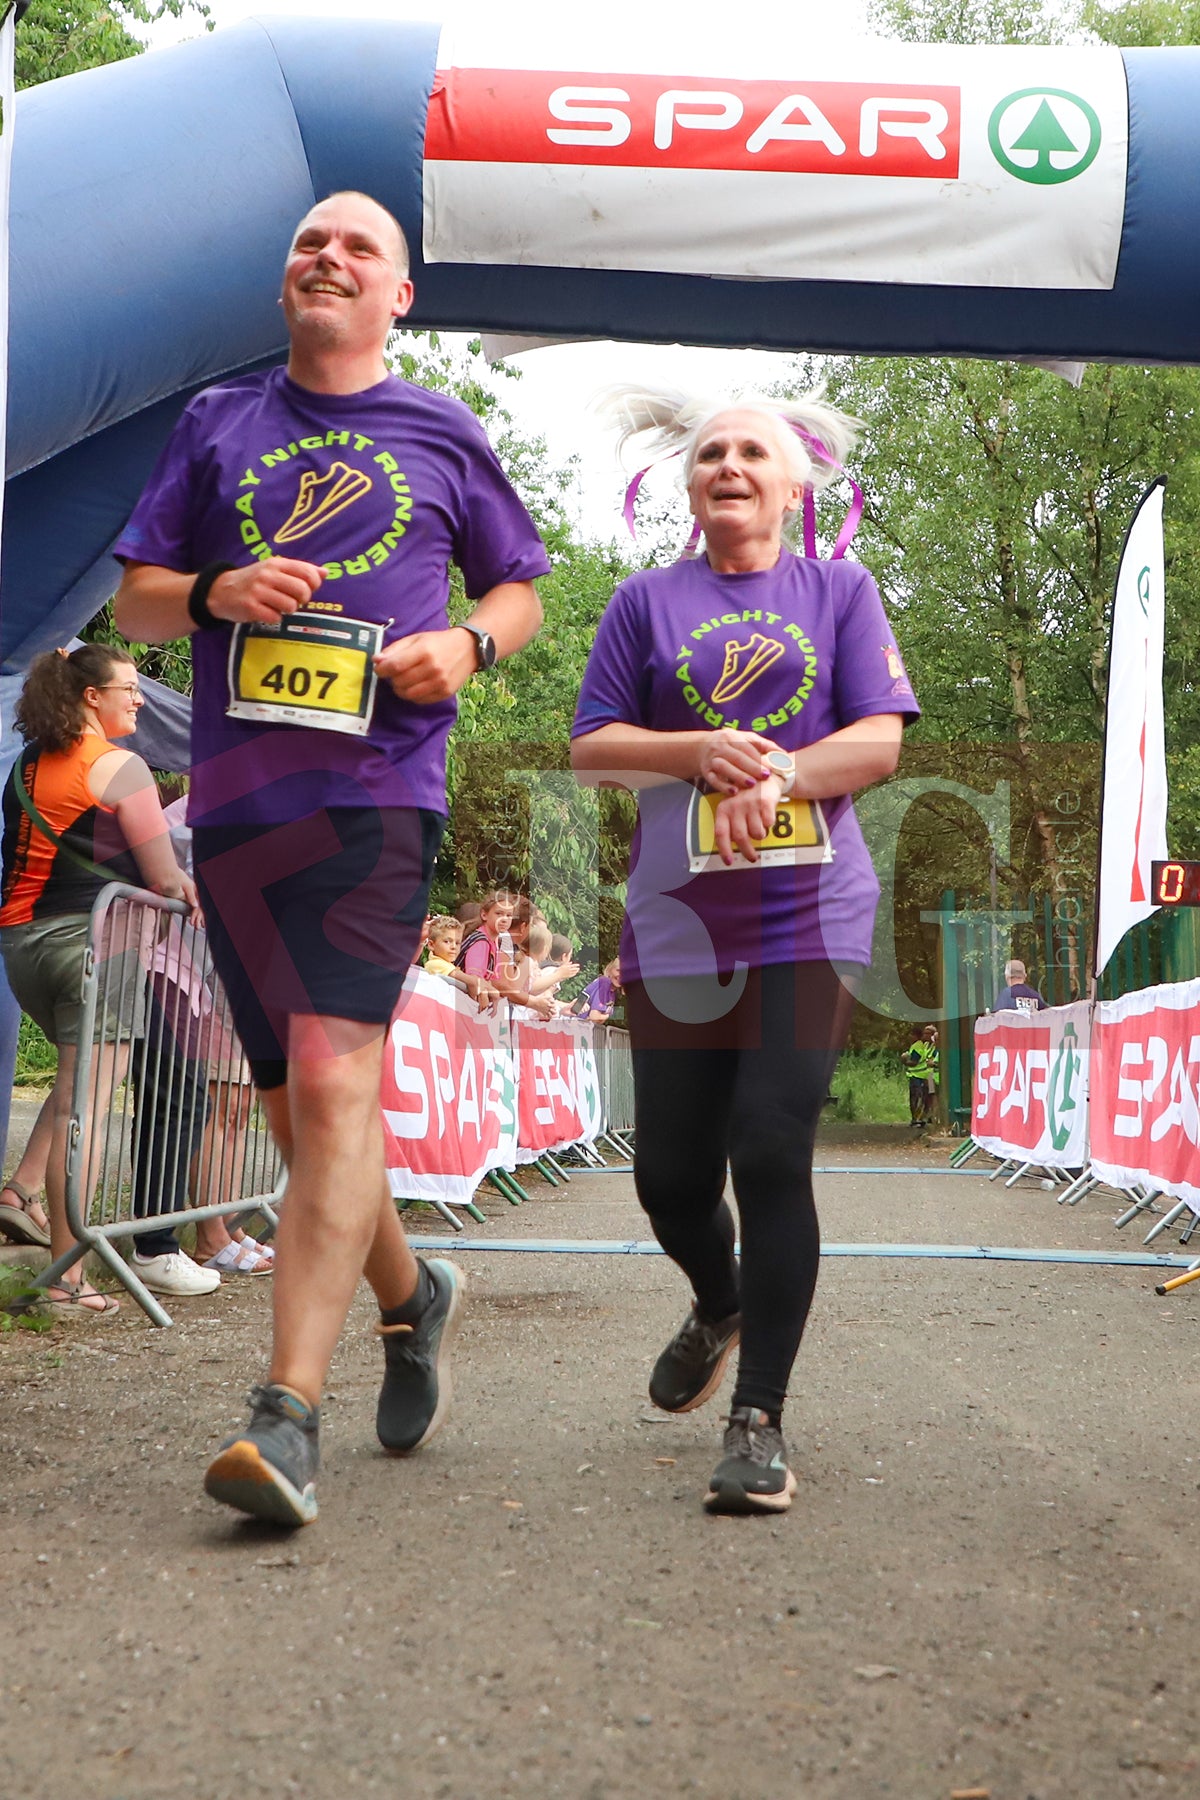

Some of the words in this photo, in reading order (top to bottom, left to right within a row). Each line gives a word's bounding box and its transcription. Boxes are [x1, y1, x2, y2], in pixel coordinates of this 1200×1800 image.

[546, 86, 950, 161] SPAR
[235, 468, 276, 561] IDAY
[260, 430, 374, 468] NIGHT
[322, 451, 413, 580] RUNNERS
[307, 601, 343, 612] 2023
[261, 664, 338, 700] 407
[690, 609, 782, 640] NIGHT
[751, 623, 817, 732] RUNNERS
[383, 1018, 515, 1143] SPAR
